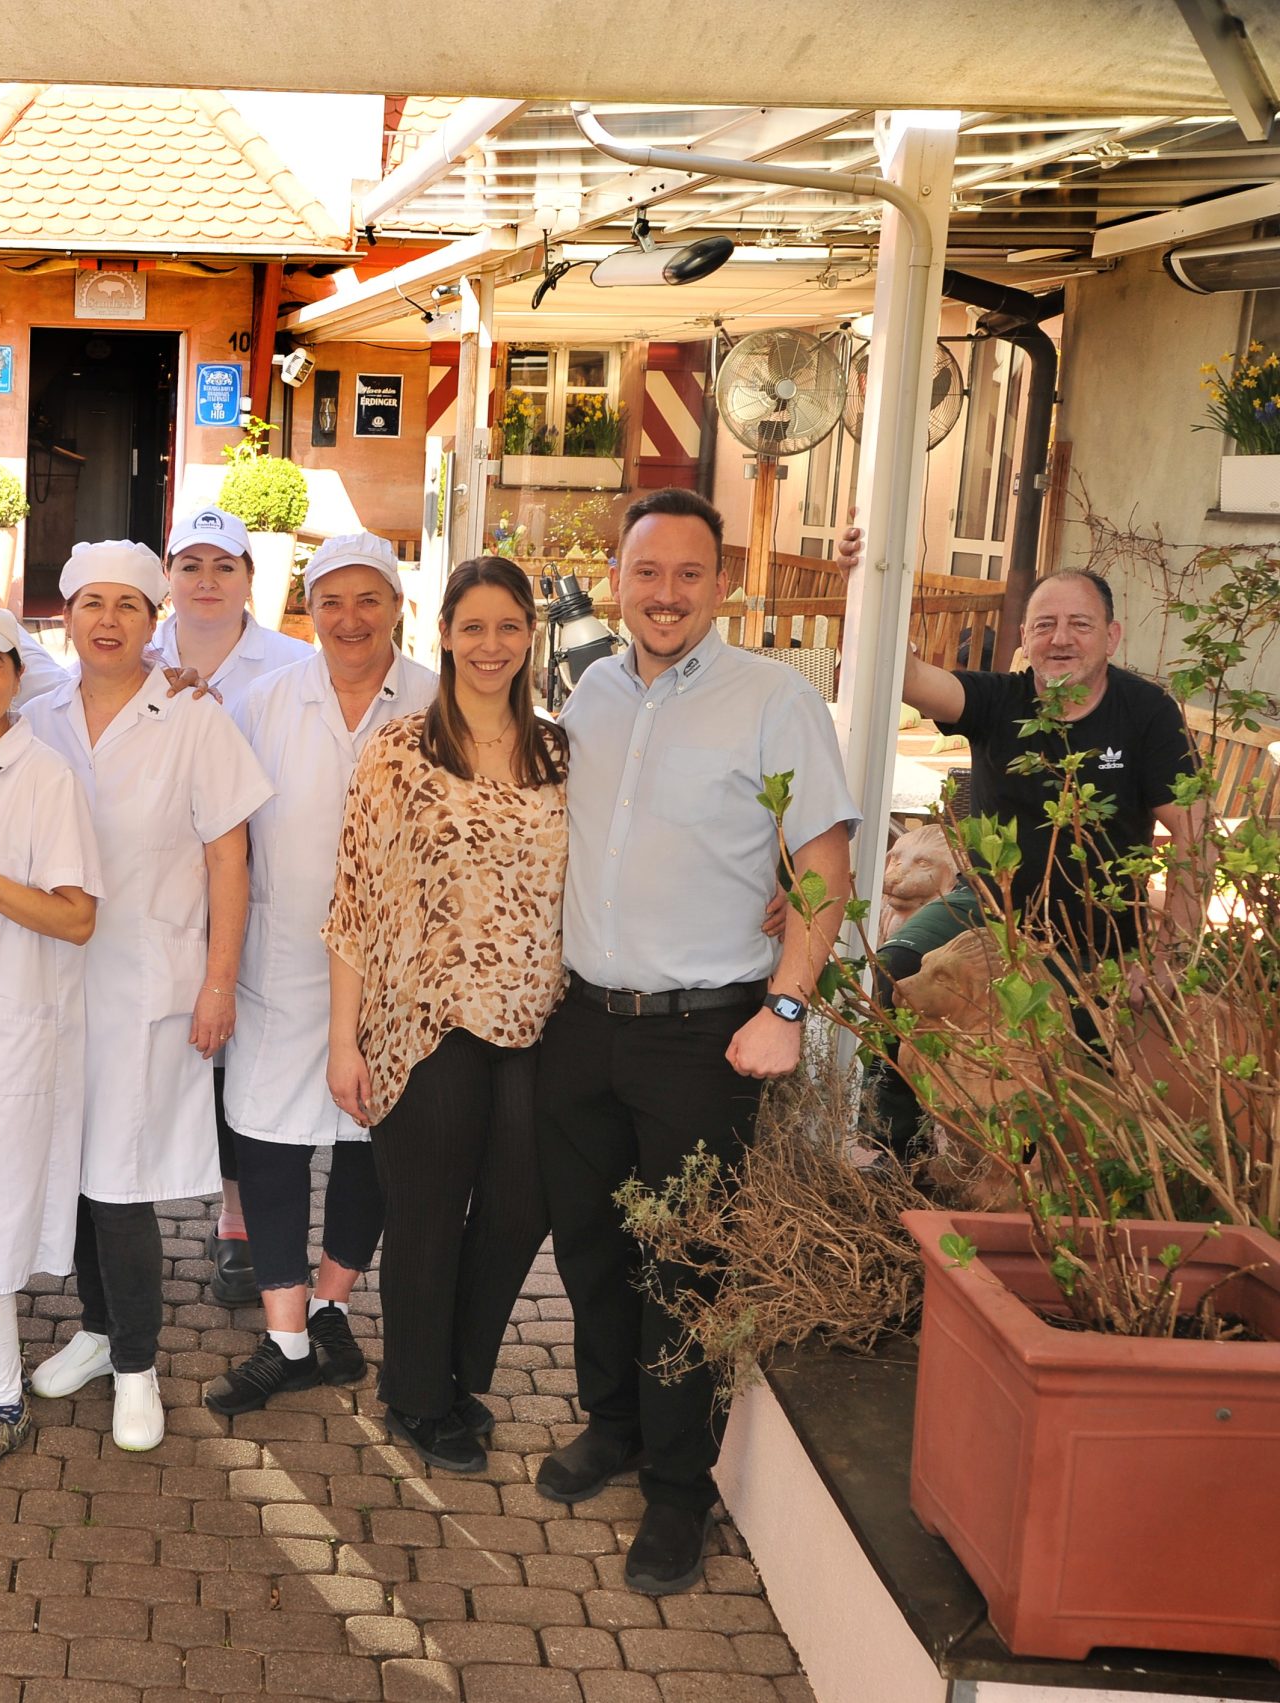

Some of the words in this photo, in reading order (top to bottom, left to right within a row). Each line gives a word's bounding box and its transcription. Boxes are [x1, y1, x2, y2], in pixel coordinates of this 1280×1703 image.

[228, 331, 251, 353] 10
[360, 396, 398, 407] ERDINGER
[1098, 762, 1124, 770] adidas
